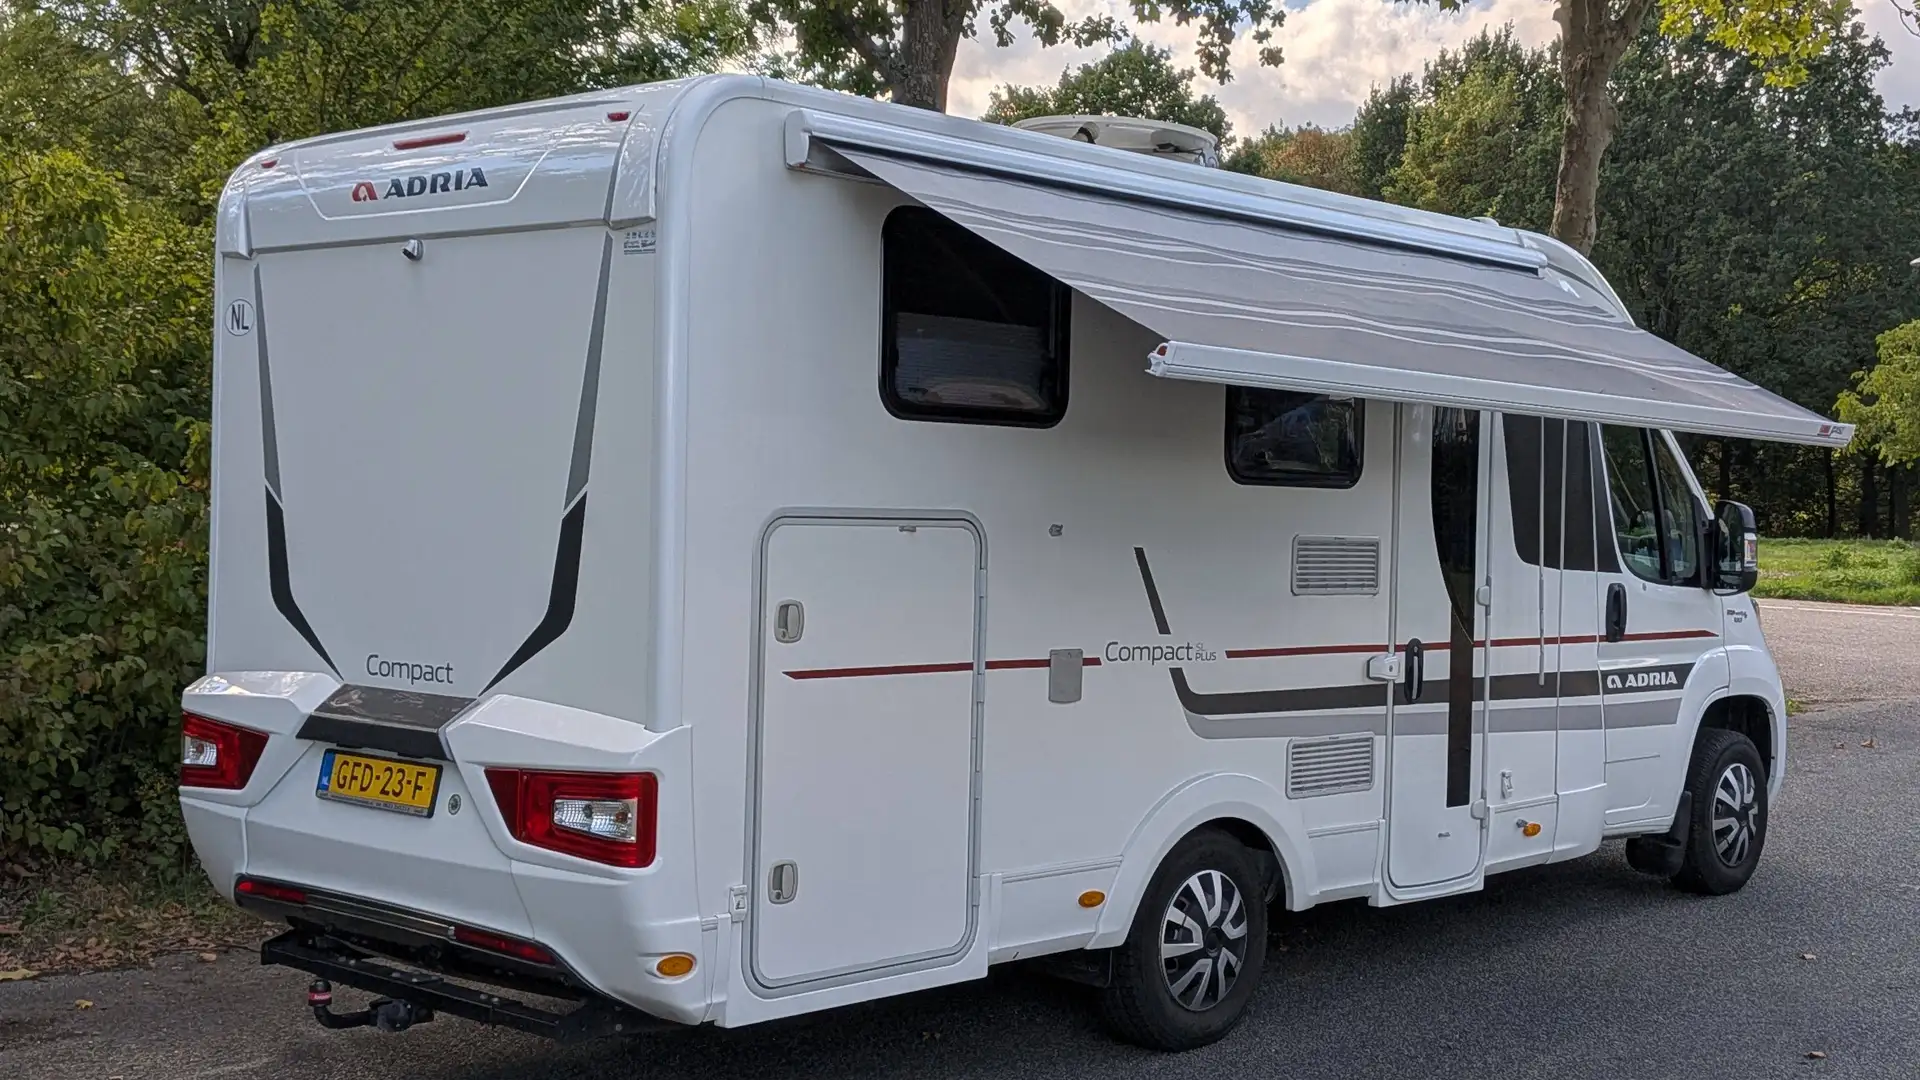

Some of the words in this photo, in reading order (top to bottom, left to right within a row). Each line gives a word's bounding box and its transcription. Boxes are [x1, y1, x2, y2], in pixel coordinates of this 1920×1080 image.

[383, 167, 488, 199] ADRIA
[231, 304, 250, 330] NL
[1105, 641, 1193, 666] Compact
[1195, 652, 1217, 661] PLUS
[366, 654, 454, 685] Compact
[1624, 671, 1678, 688] ADRIA
[336, 760, 427, 800] GFD-23-F
